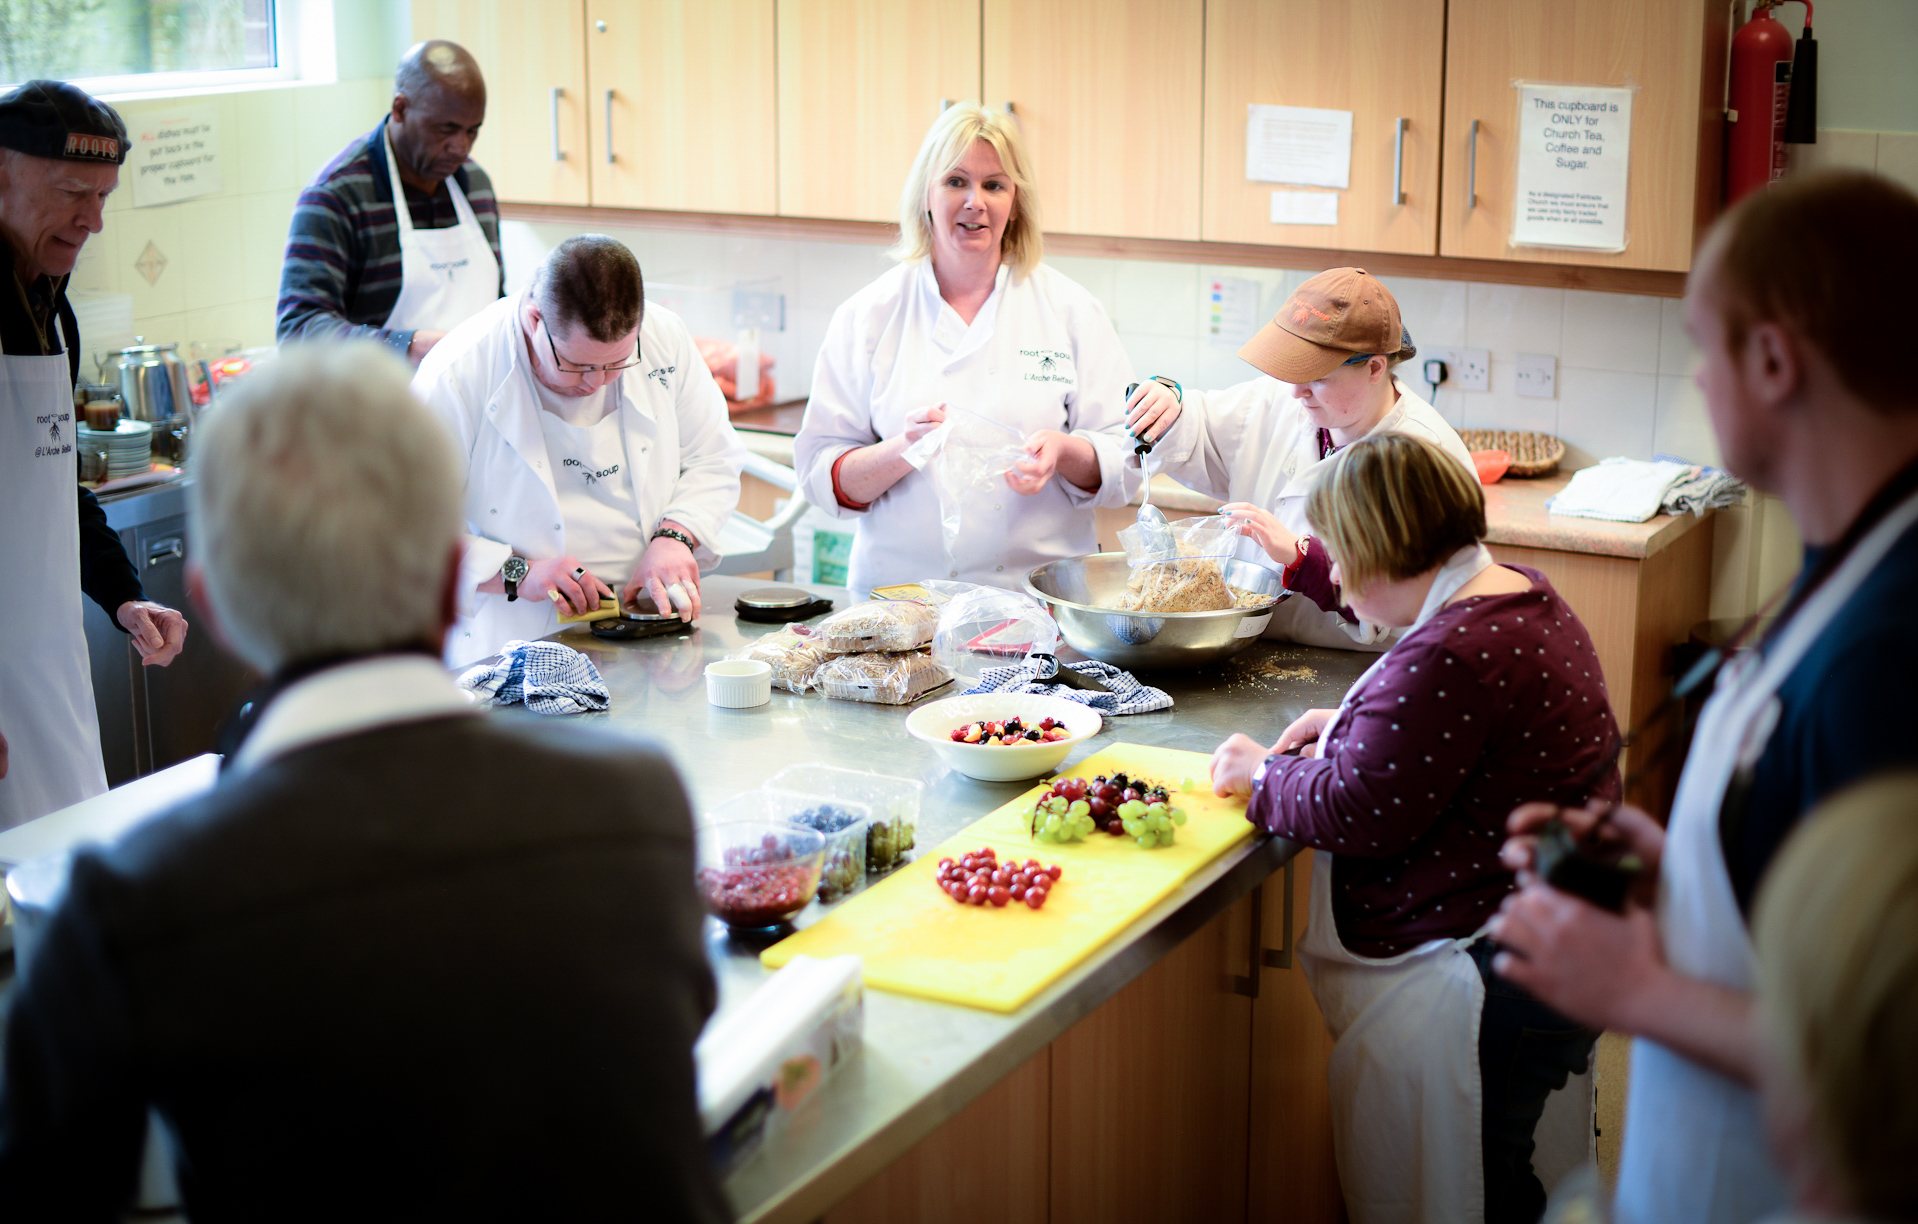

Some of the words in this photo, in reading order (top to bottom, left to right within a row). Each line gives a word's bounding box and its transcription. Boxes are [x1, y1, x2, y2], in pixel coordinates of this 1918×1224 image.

[1534, 97, 1555, 110] This
[1558, 101, 1607, 113] cupboard
[1610, 102, 1619, 113] is
[1551, 113, 1582, 125] ONLY
[1585, 115, 1599, 126] for
[1543, 127, 1580, 139] Church
[1584, 129, 1605, 142] Tea,
[67, 136, 117, 159] ROOTS
[1545, 142, 1579, 154] Coffee
[1582, 146, 1602, 155] and
[1555, 157, 1589, 171] Sugar.
[37, 414, 51, 424] root
[596, 464, 619, 478] soup
